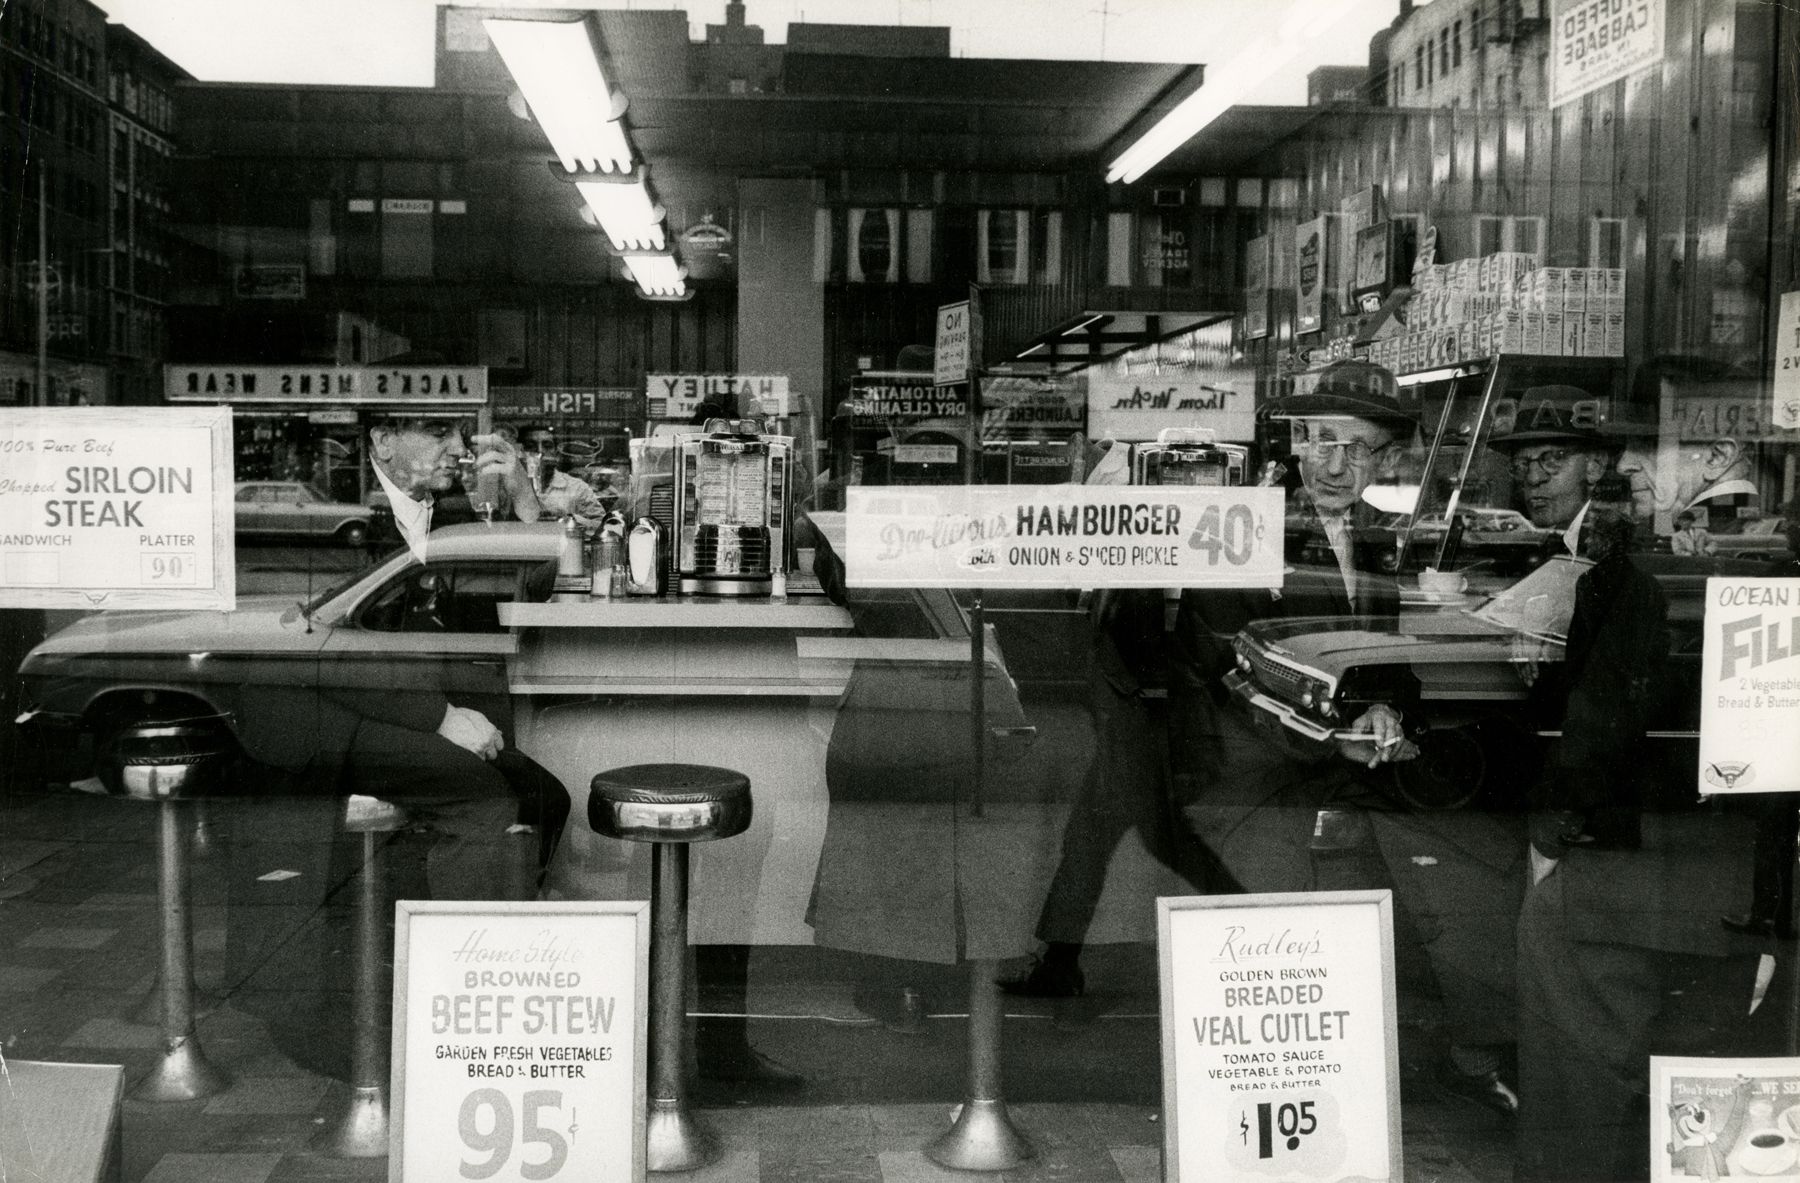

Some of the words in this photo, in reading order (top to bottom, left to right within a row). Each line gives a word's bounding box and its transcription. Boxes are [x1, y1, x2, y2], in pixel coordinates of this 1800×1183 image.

[43, 439, 77, 454] Pure
[83, 438, 116, 456] Beef
[65, 466, 193, 494] SIRLOIN
[45, 500, 144, 527] STEAK
[1016, 504, 1181, 537] HAMBURGER
[140, 535, 196, 546] PLATTER
[1008, 546, 1061, 567] ONION
[1065, 551, 1075, 564] &
[1131, 546, 1179, 567] PICKLE
[1719, 586, 1789, 607] OCEAN
[1718, 696, 1751, 709] Bread
[1754, 697, 1765, 709] &
[452, 928, 520, 963] Home
[1218, 925, 1321, 964] Rudley's
[464, 970, 581, 989] BROWNED
[1219, 969, 1274, 982] GOLDEN
[1280, 967, 1328, 981] BROWN
[1224, 983, 1324, 1008] BREADED
[432, 994, 515, 1035] BEEF
[522, 994, 616, 1035] STEW
[1192, 1015, 1252, 1046] VEAL
[1261, 1011, 1350, 1043] CUTLET
[435, 1045, 487, 1061] GARDEN
[494, 1046, 534, 1061] FRESH
[540, 1046, 613, 1062] VEGETABLES
[1222, 1052, 1276, 1065] TOMATO
[1282, 1050, 1325, 1063] SAUCE
[467, 1064, 515, 1079] BREAD
[531, 1064, 587, 1080] BUTTER
[1208, 1067, 1279, 1080] VEGETABLE
[1285, 1066, 1294, 1077] &
[1298, 1063, 1341, 1077] POTATO
[1230, 1082, 1267, 1092] BREAD
[1282, 1079, 1321, 1090] BUTTER
